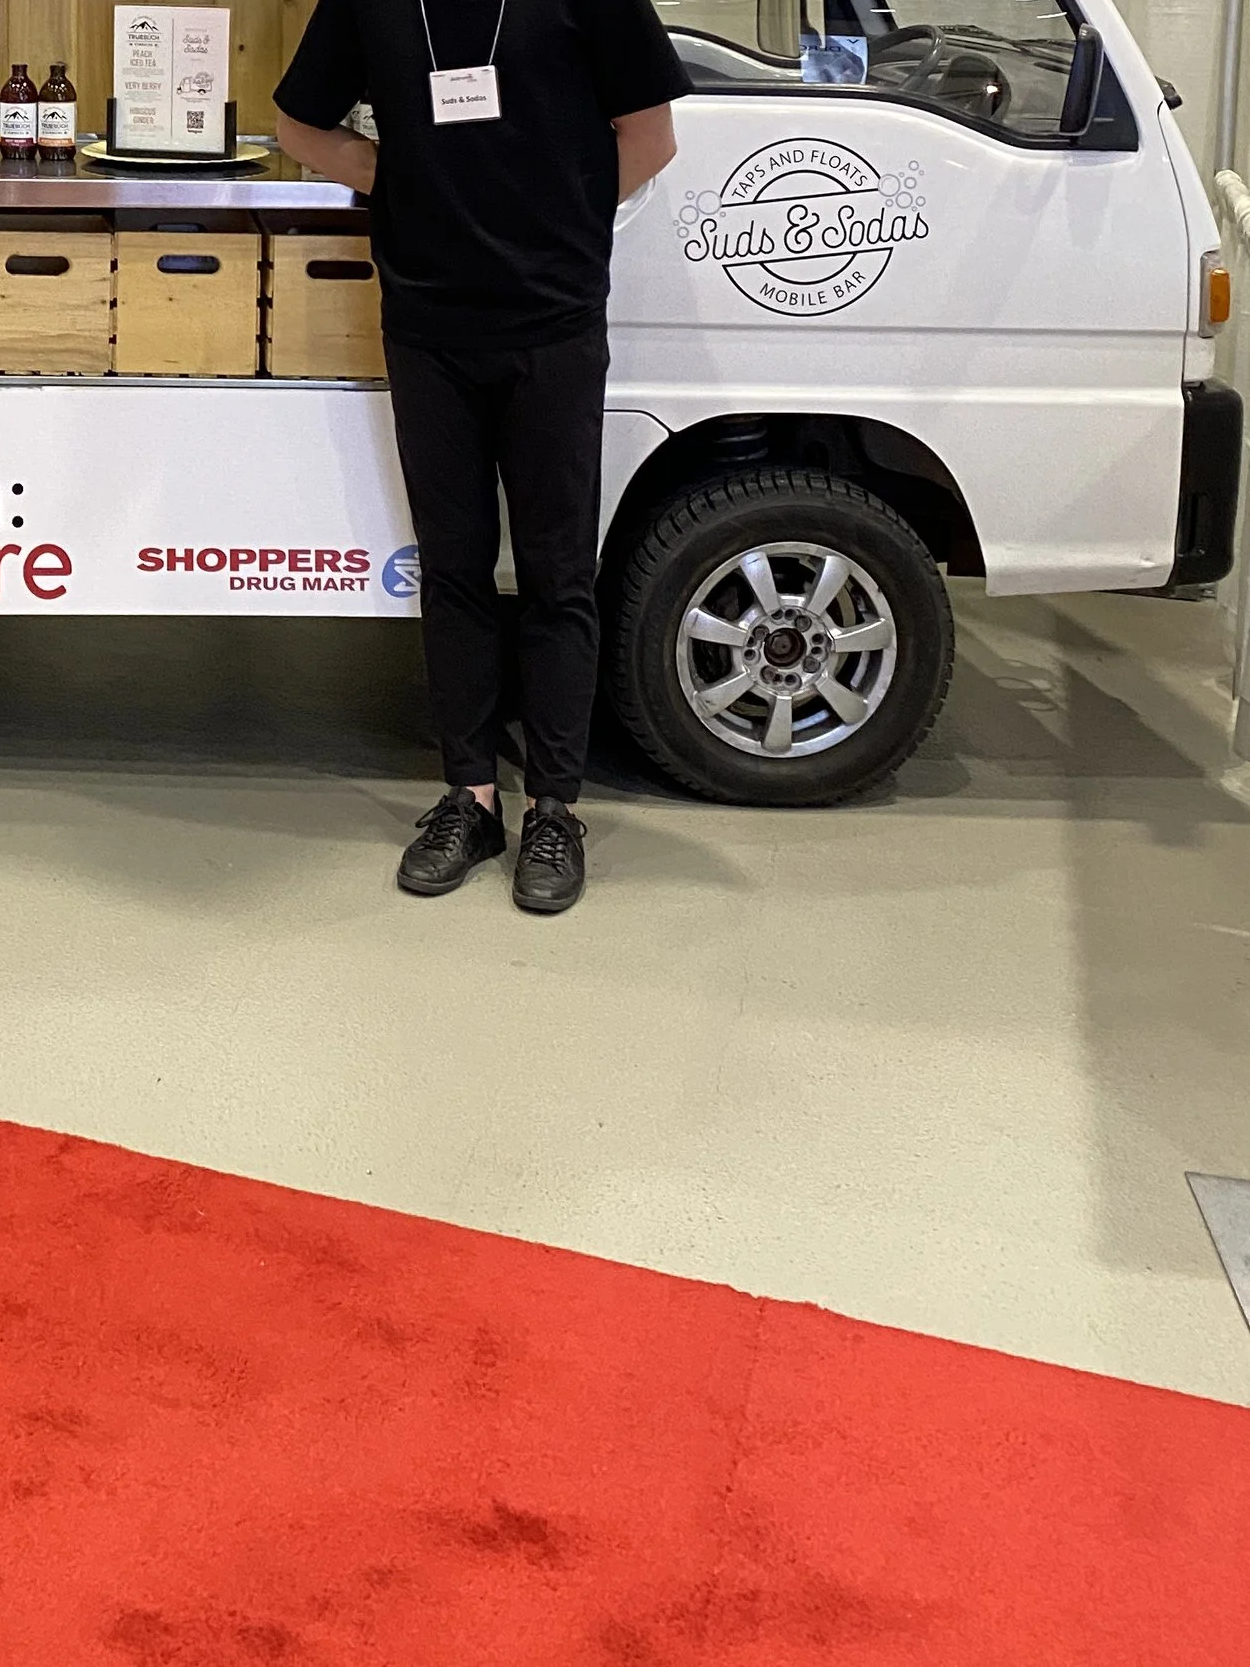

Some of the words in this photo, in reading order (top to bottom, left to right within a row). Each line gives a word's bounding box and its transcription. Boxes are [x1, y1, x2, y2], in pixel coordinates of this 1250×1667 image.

[466, 94, 487, 103] Sodas
[731, 165, 767, 201] TAPS
[768, 149, 805, 170] AND
[810, 149, 869, 188] FLOATS
[684, 218, 775, 262] Suds
[784, 204, 820, 254] &
[821, 205, 930, 249] Sodas
[759, 282, 828, 307] MOBILE
[833, 270, 867, 299] BAR
[136, 547, 371, 574] SHOPPERS
[229, 576, 296, 591] DRUG
[302, 577, 370, 592] MART
